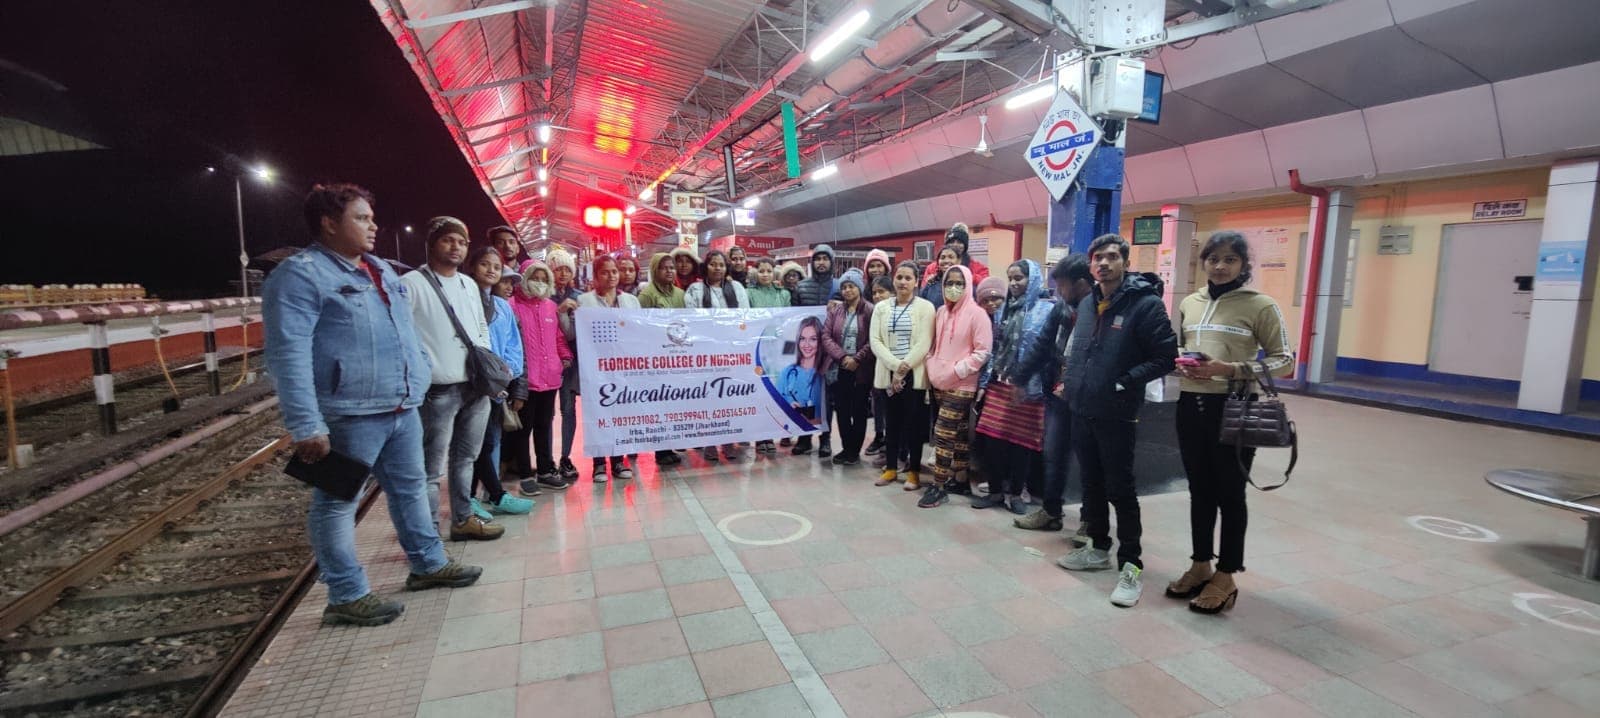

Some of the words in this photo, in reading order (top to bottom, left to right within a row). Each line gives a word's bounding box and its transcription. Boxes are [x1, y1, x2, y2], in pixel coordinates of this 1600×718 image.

[1048, 139, 1069, 150] माल
[1038, 160, 1052, 180] NEW
[1054, 170, 1071, 181] MAL
[1072, 151, 1085, 170] JN.
[1475, 210, 1499, 218] RELAY
[748, 239, 775, 249] Amul
[598, 356, 649, 372] FLORENCE
[652, 354, 693, 370] COLLEGE
[696, 354, 708, 368] OF
[710, 352, 752, 367] NURSING
[599, 381, 707, 408] Educational
[710, 376, 757, 398] Tour
[712, 406, 757, 419] 6205145470
[646, 425, 667, 434] Ranchi
